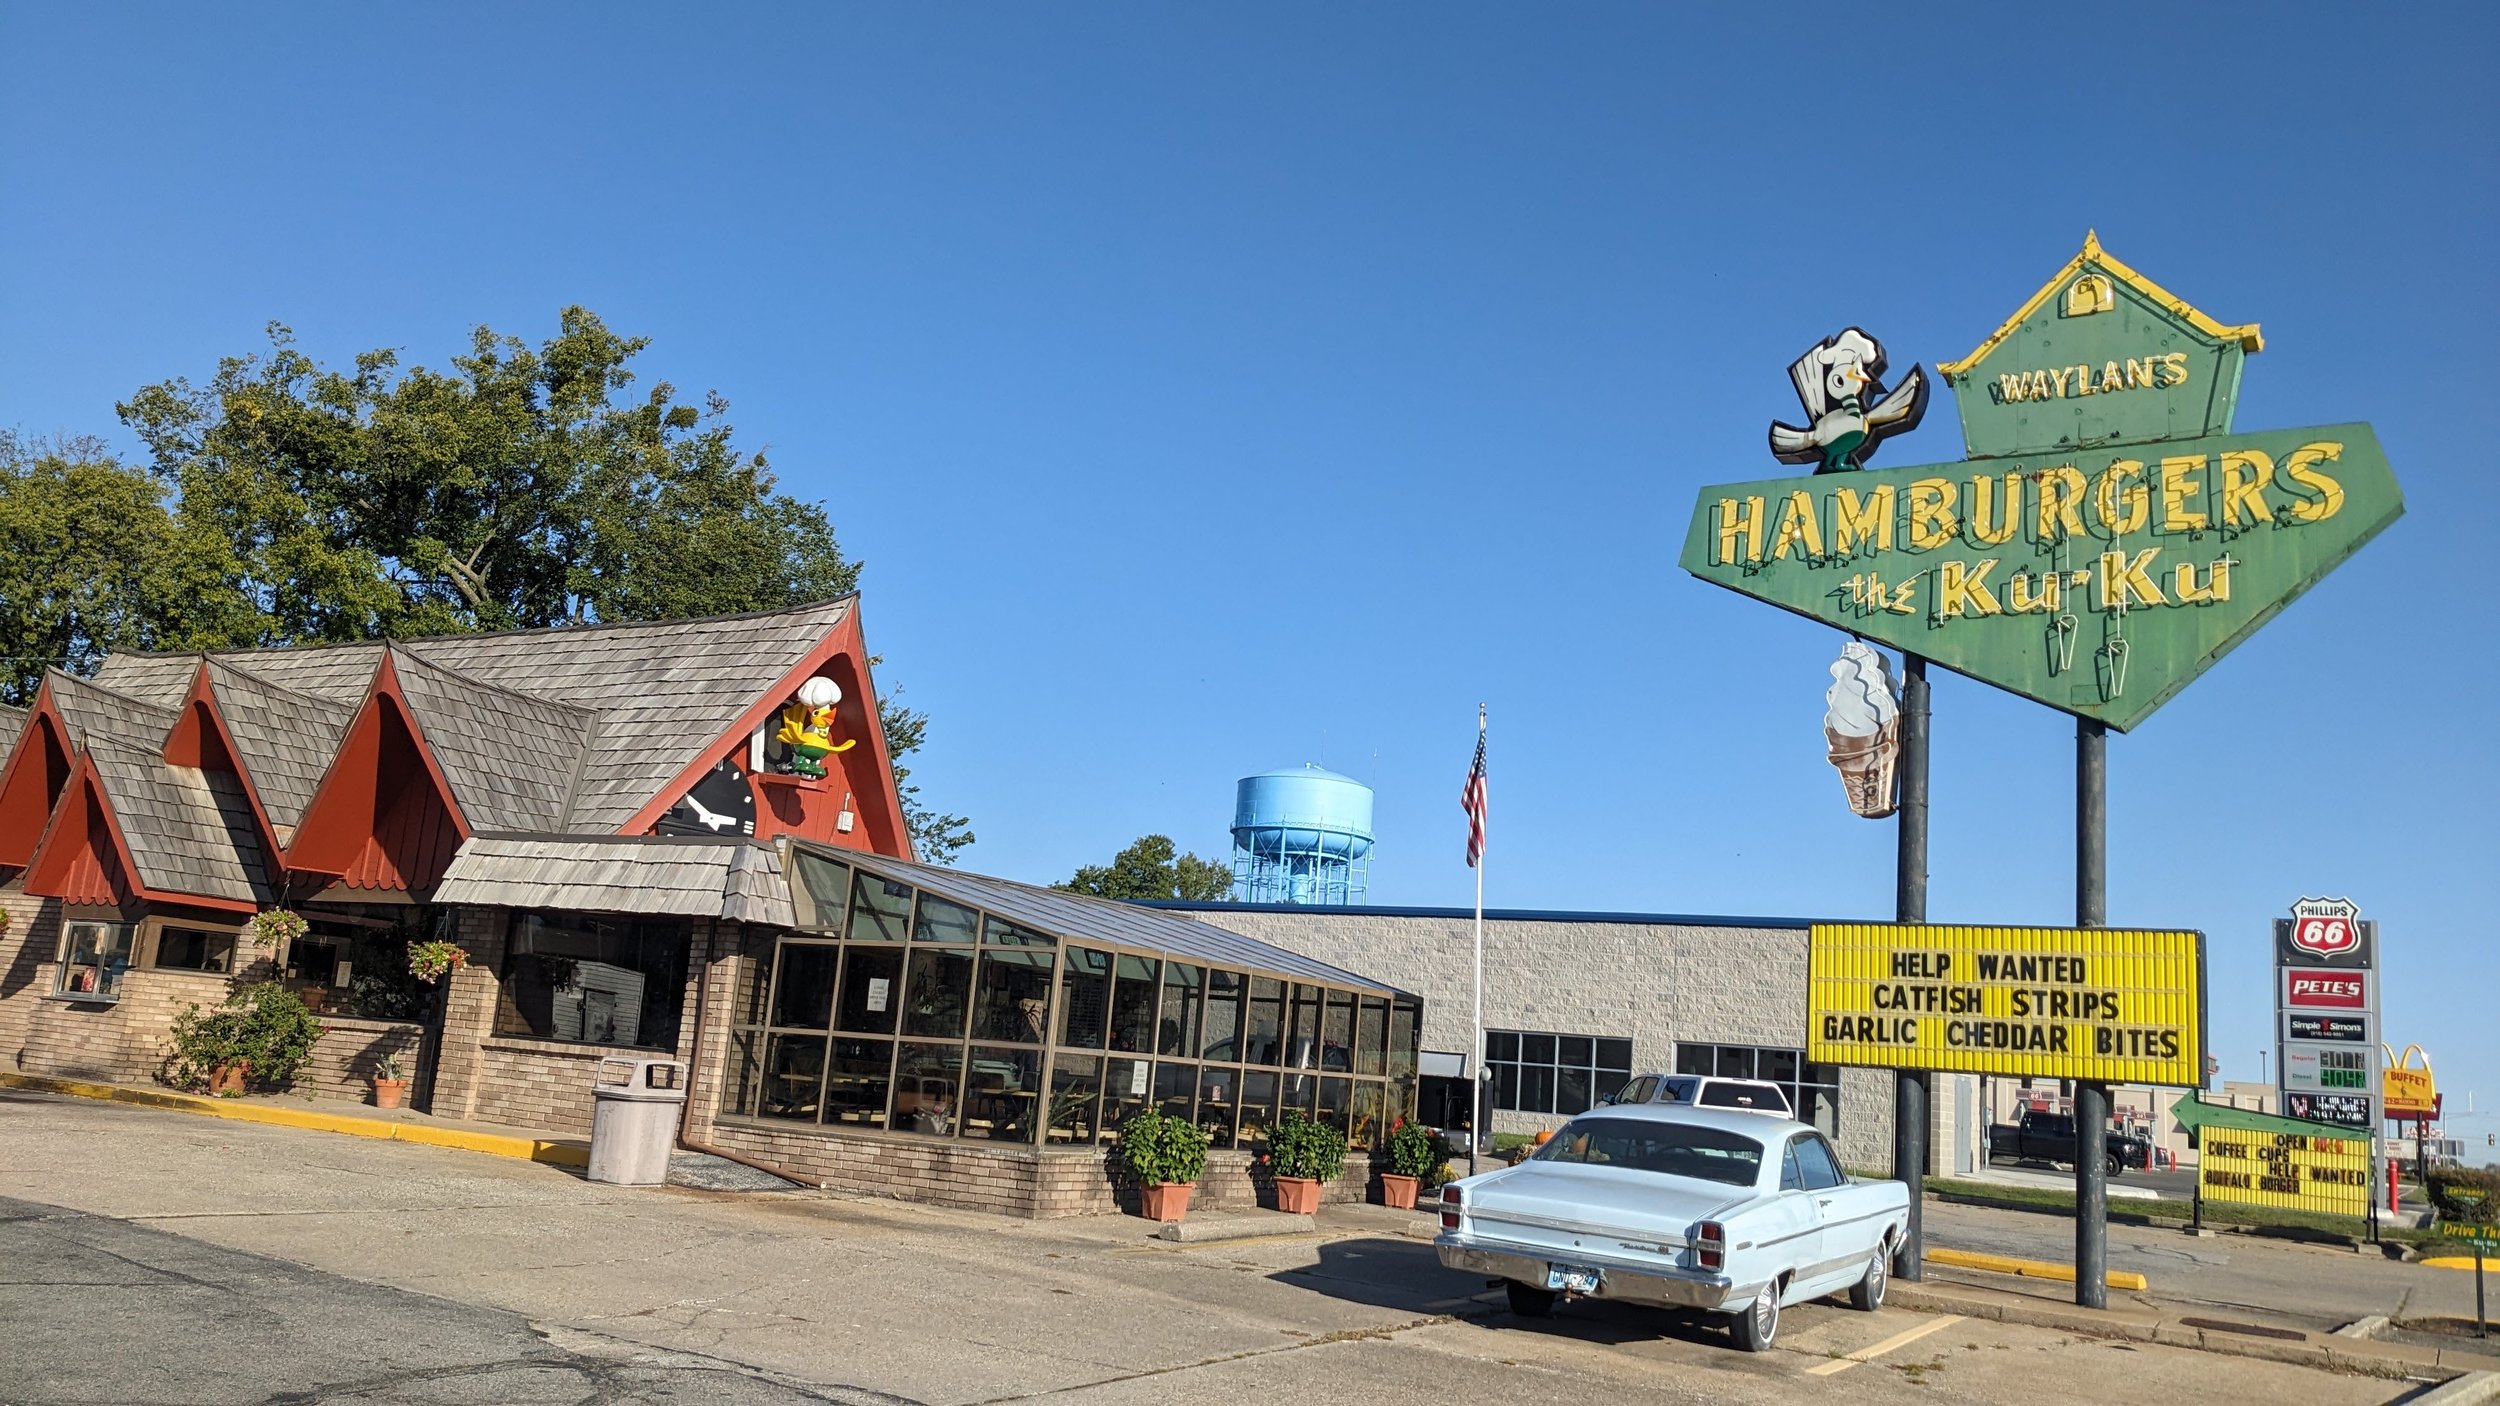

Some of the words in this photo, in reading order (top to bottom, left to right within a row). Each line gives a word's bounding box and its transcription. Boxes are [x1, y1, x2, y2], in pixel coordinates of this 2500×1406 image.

[1718, 442, 2345, 565] HAMBURGERS
[1841, 570, 1918, 614] the
[2300, 905, 2348, 917] PHILLIPS
[2303, 921, 2346, 944] 66
[1892, 952, 1951, 979] HELP
[1978, 954, 2086, 983] WANTED
[2293, 979, 2361, 996] PETE'S
[1874, 984, 1982, 1014] CATFISH
[2012, 989, 2119, 1019] STRIPS
[1823, 1015, 1917, 1044] GARLIC
[1947, 1020, 2068, 1053] CHEDDAR
[2096, 1026, 2179, 1058] BITES
[2292, 1020, 2321, 1031] Simple
[2391, 1071, 2427, 1088] BUFFET
[2207, 1141, 2248, 1159] COFFEE
[2259, 1147, 2290, 1162] CUPS
[2276, 1134, 2307, 1150] OPEN
[2206, 1170, 2250, 1188] BUFFALO
[2260, 1176, 2300, 1193] BURGER
[2269, 1162, 2299, 1180] HELP
[2312, 1166, 2365, 1185] WANTED
[2444, 1223, 2476, 1237] Drive
